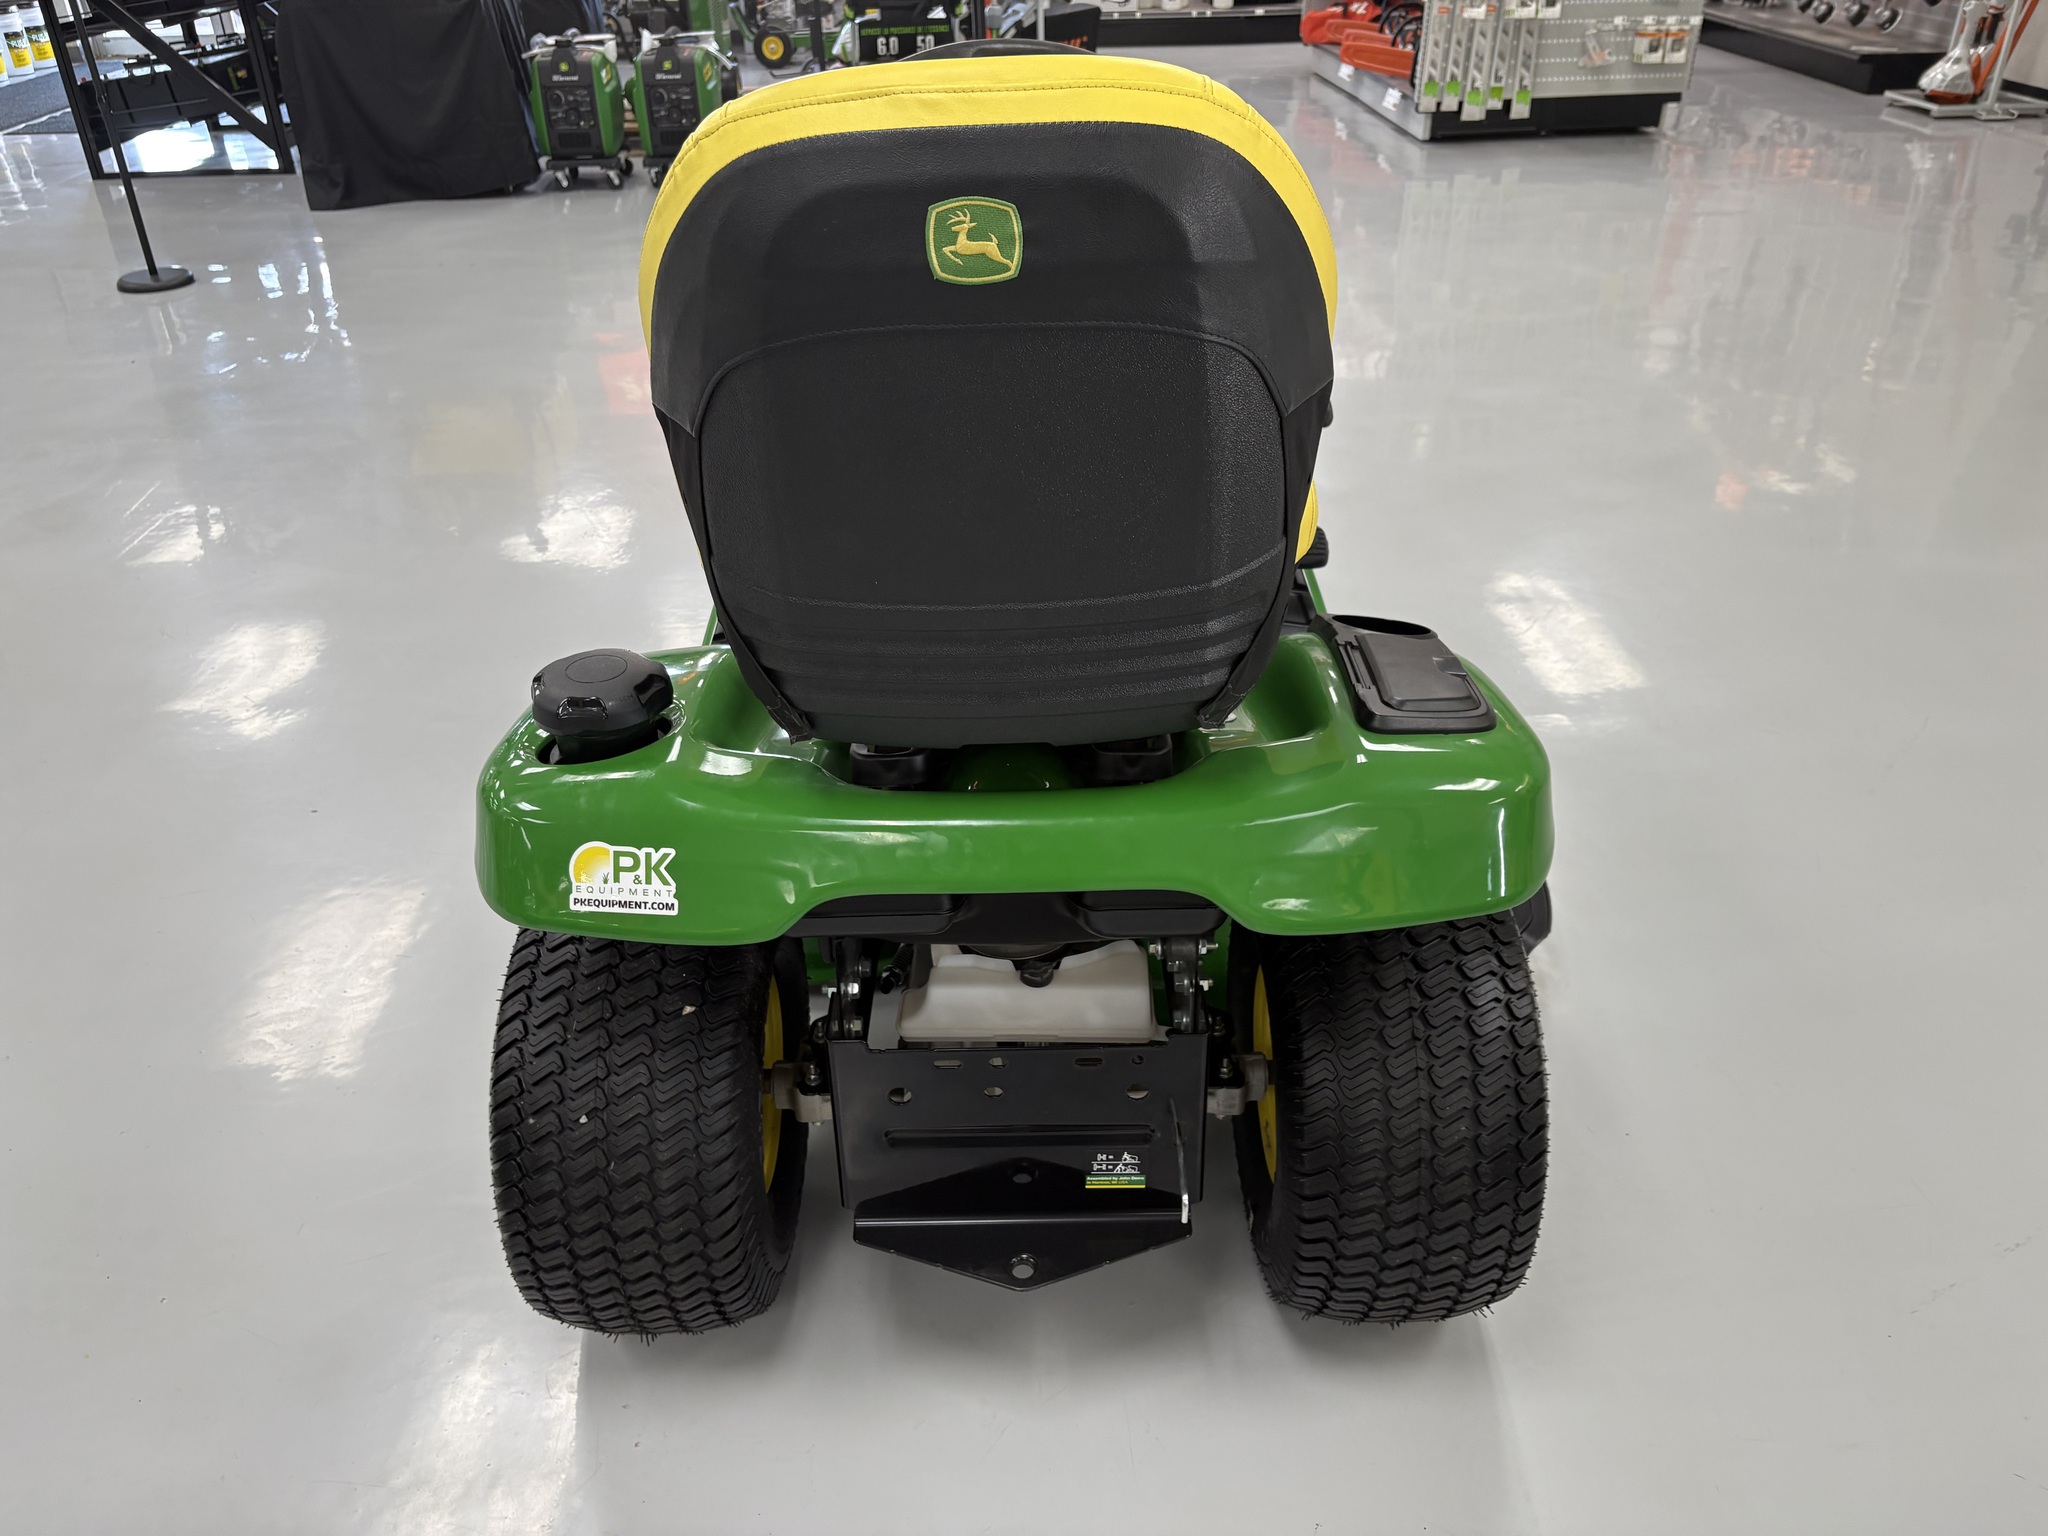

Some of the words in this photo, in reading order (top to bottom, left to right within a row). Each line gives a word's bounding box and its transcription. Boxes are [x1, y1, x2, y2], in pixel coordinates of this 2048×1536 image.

[612, 850, 673, 886] P&K
[575, 885, 673, 898] EQUIPMENT
[573, 897, 676, 911] PKEQUIPMENT.COM
